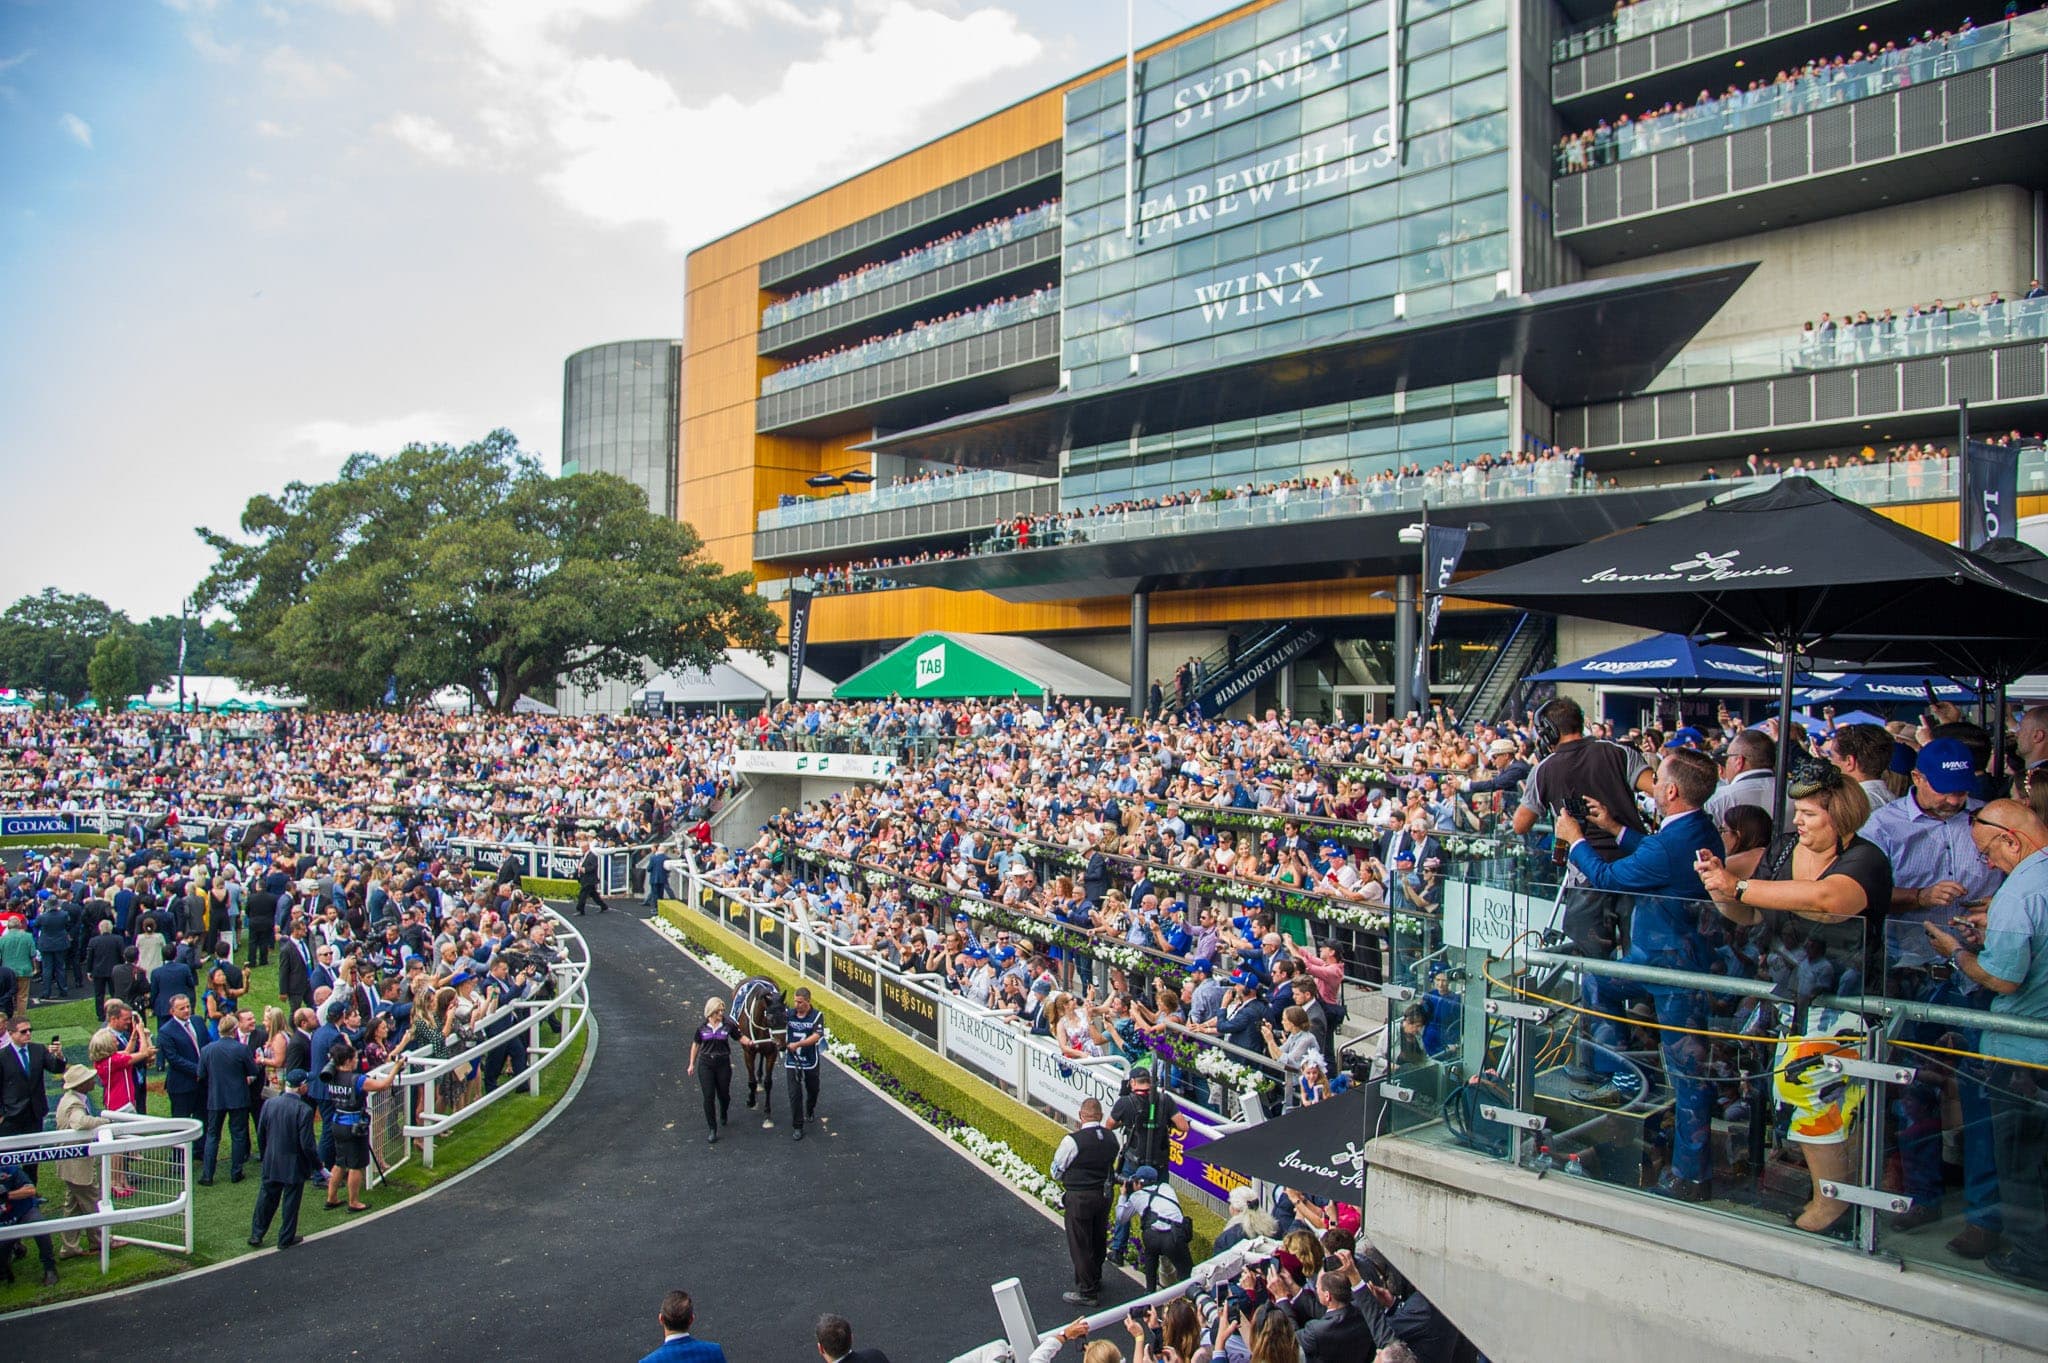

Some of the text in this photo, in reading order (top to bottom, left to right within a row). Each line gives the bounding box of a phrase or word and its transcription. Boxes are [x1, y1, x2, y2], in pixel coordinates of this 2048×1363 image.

[1173, 27, 1348, 129] SYDNEY
[1139, 123, 1395, 239] FAREWELLS
[1195, 256, 1324, 324] WINX
[1984, 490, 1999, 541] LO
[1581, 564, 1793, 583] James Squire
[792, 609, 804, 689] LONGINES
[920, 658, 942, 674] TAB
[1215, 627, 1317, 706] #IMMORTALWINX
[834, 956, 873, 988] THE STAR
[885, 983, 933, 1020] THE STAR
[950, 1007, 1014, 1056] HARROLDS
[328, 1084, 352, 1096] MEDIA
[1032, 1049, 1114, 1107] HAROLDS
[1279, 1149, 1339, 1178] James
